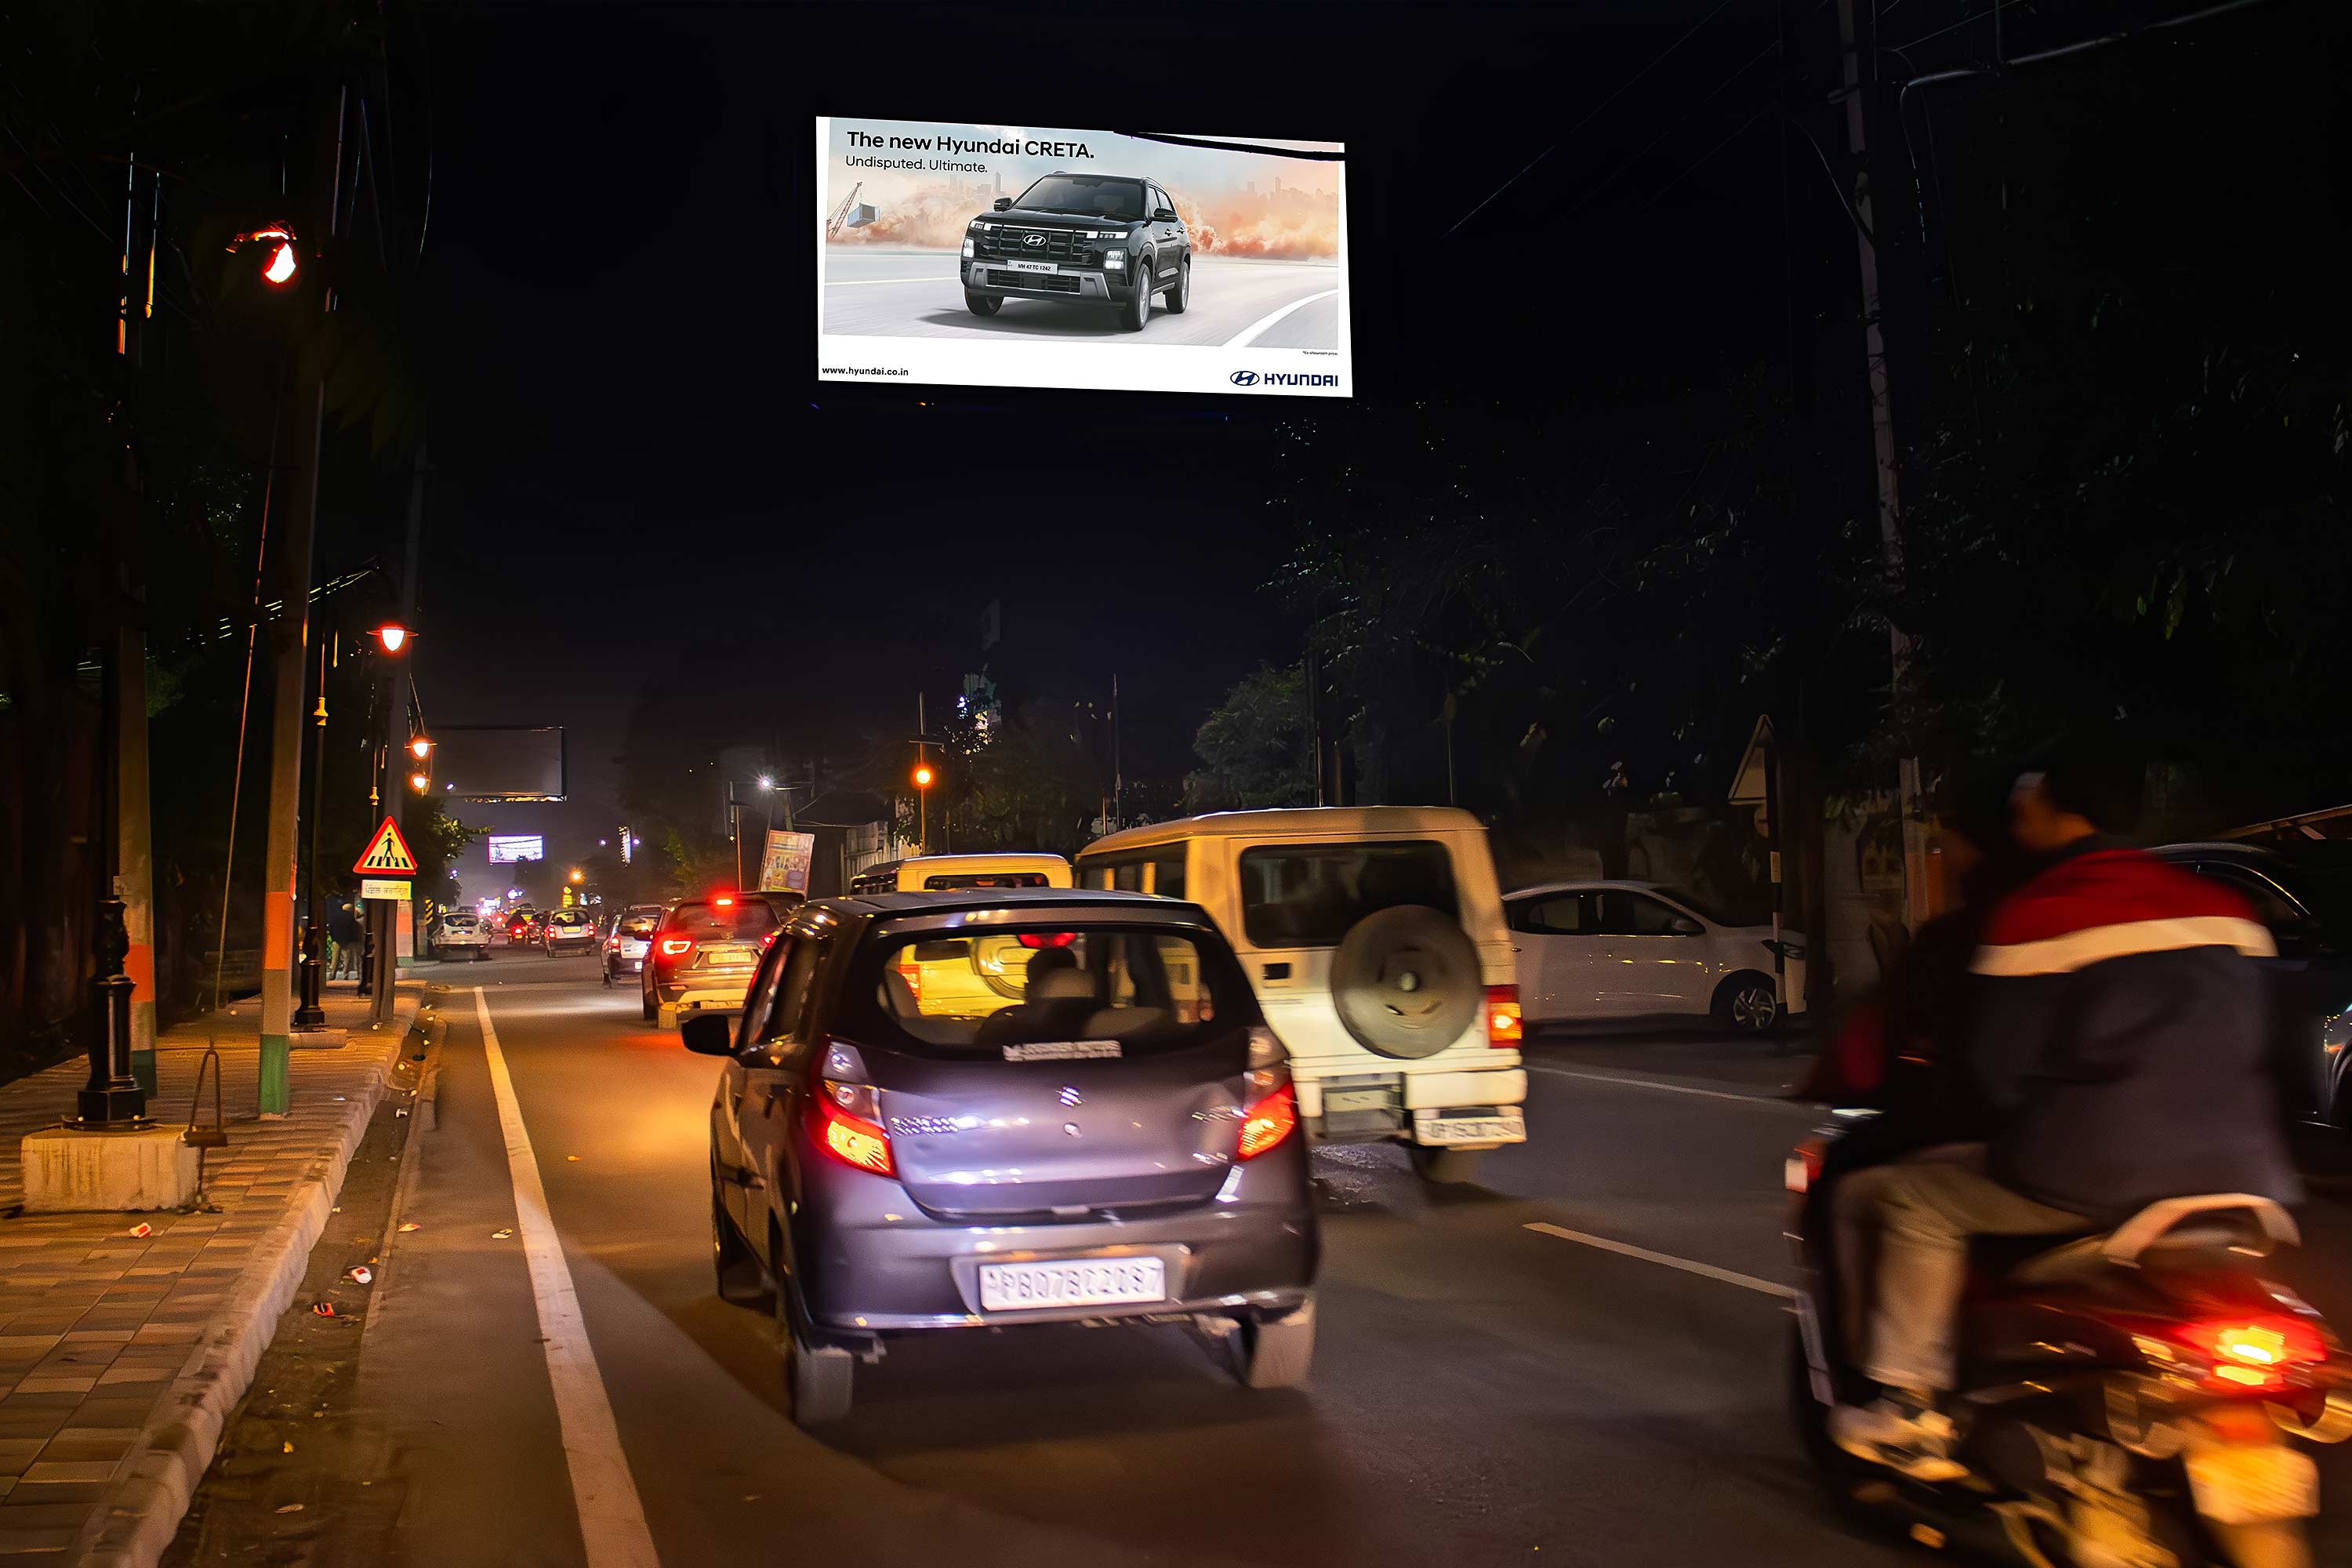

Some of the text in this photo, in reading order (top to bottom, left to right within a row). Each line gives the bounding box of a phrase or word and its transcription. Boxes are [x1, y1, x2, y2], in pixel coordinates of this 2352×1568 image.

[848, 132, 1094, 158] The new Hyundai CRETA.
[846, 155, 987, 172] Undisputed. Ultimate.
[822, 366, 909, 376] www.hyundai.co.in
[1264, 372, 1338, 387] HYUNDAI
